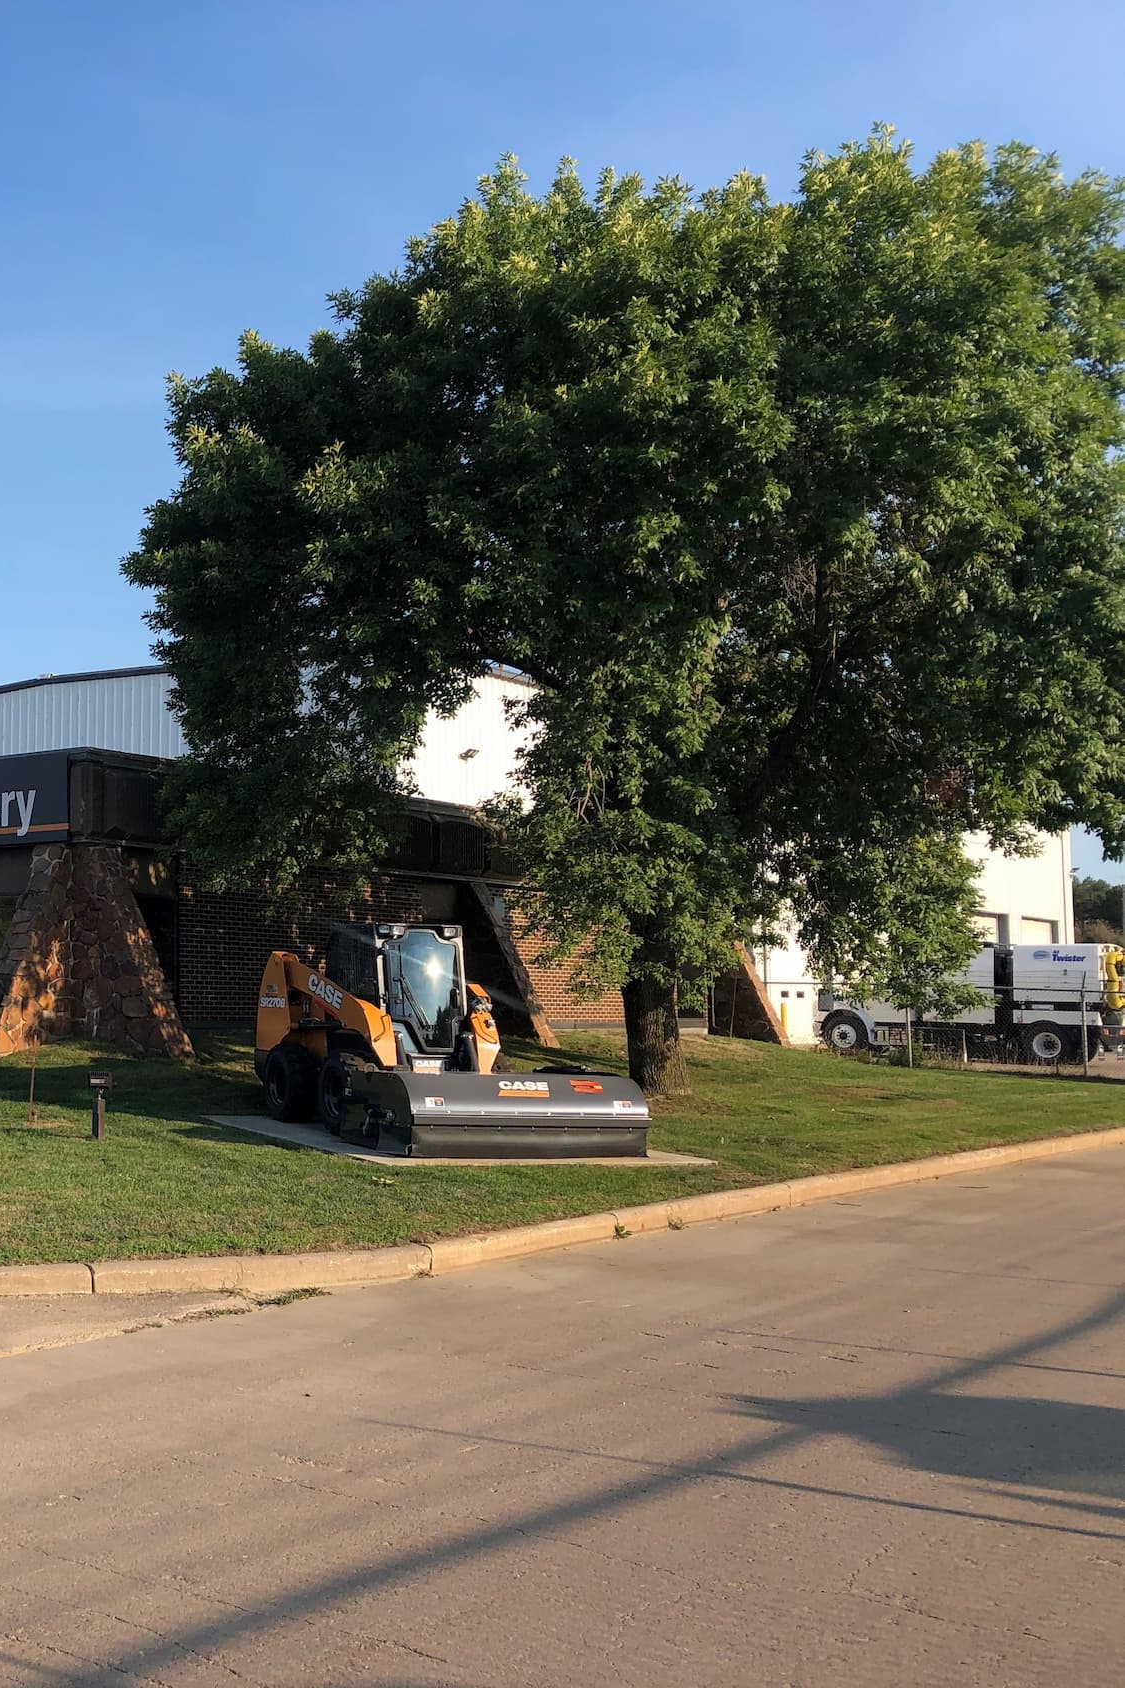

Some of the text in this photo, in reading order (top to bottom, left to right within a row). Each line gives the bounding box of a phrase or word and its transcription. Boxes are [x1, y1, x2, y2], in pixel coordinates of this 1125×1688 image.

[1052, 954, 1086, 962] Twister
[308, 974, 343, 1009] CASE
[260, 997, 286, 1008] SR270B
[498, 1080, 550, 1090] CASE
